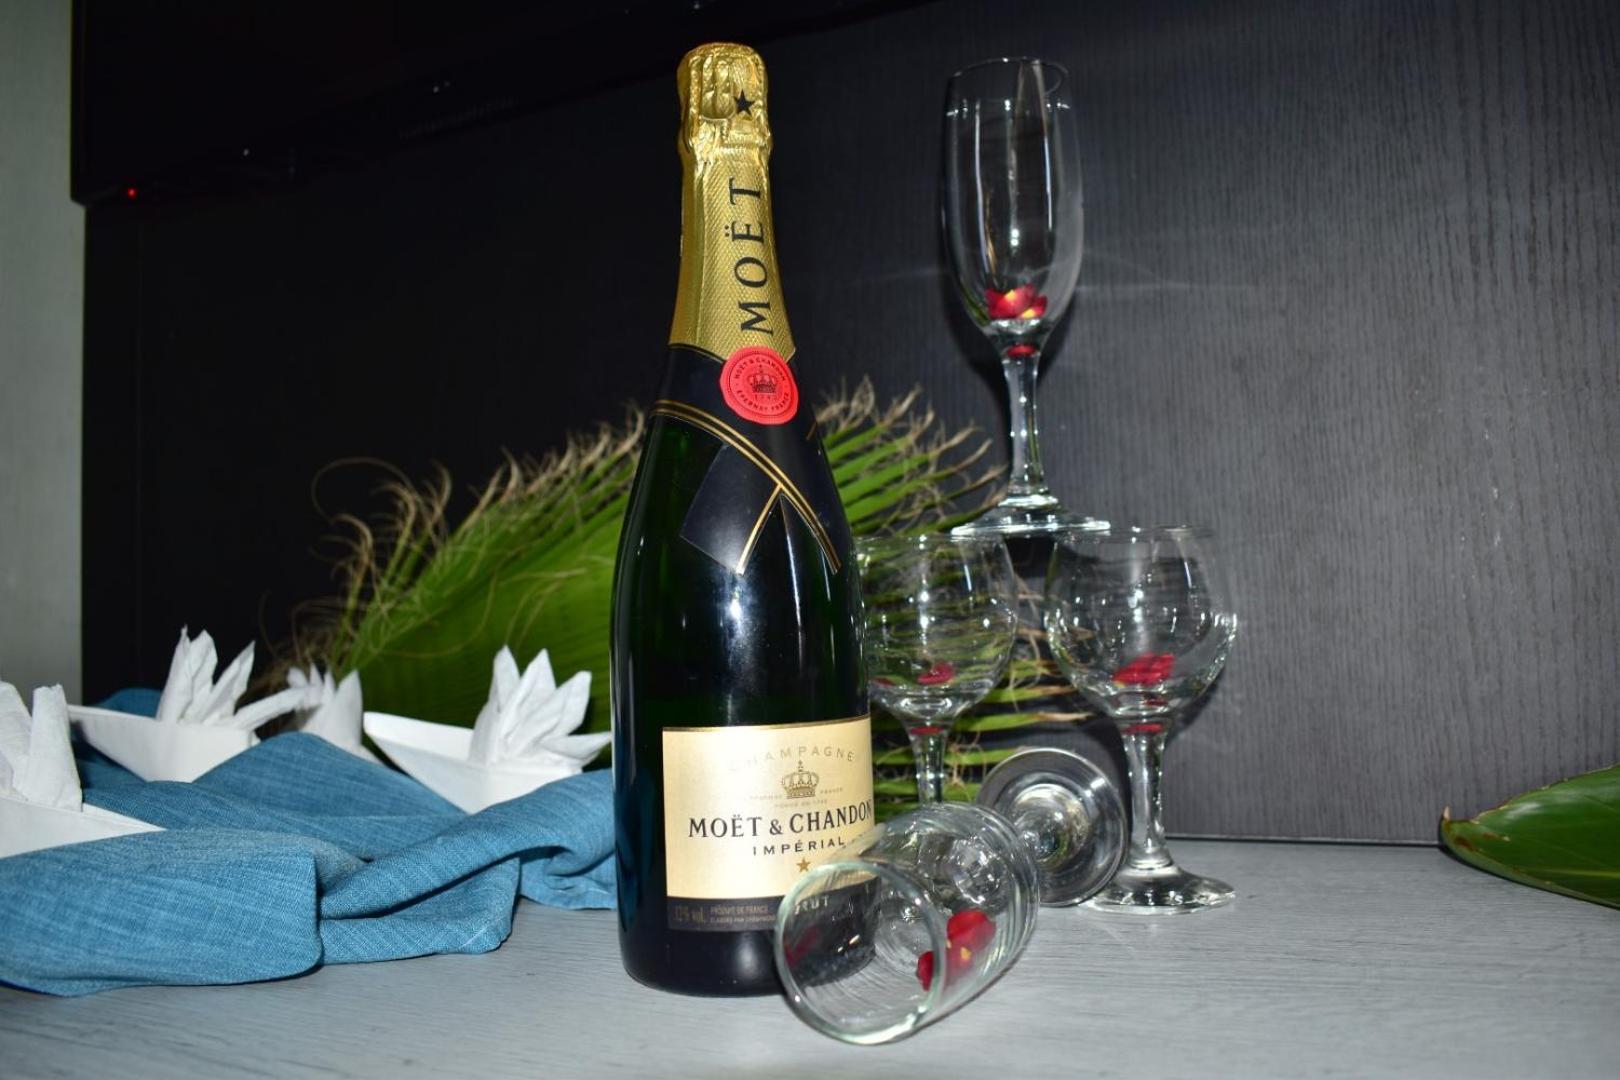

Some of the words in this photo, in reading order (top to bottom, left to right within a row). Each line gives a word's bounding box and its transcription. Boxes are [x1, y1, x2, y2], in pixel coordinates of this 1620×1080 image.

[725, 177, 774, 336] MOËT
[688, 814, 763, 838] MOËT
[769, 818, 784, 836] &
[789, 799, 873, 834] CHANDON
[752, 836, 845, 856] IMPÉRIAL
